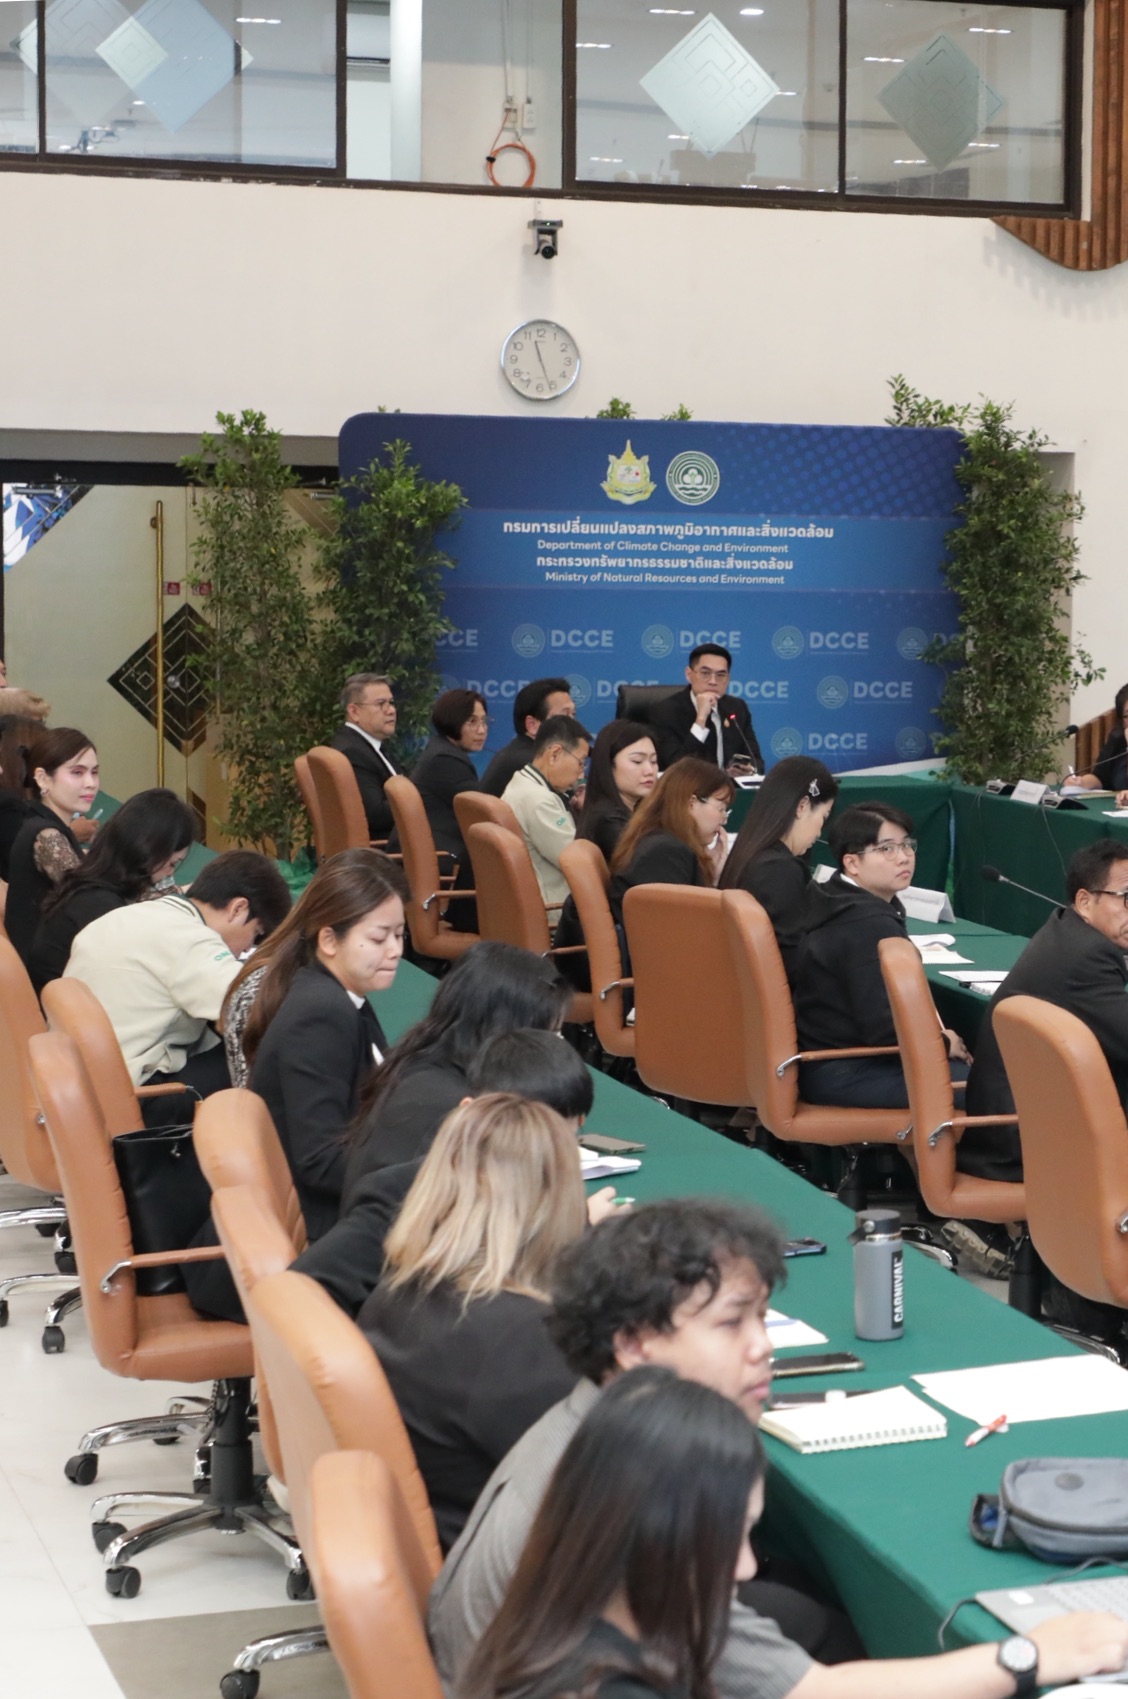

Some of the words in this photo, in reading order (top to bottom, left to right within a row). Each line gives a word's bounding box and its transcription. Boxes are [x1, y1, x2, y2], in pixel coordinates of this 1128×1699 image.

[524, 331, 531, 340] 11
[536, 328, 546, 338] 12
[513, 341, 523, 351] 10
[560, 342, 568, 352] 2
[509, 354, 518, 364] 9
[563, 356, 572, 366] 3
[513, 368, 521, 378] 8
[559, 370, 567, 378] 4
[535, 383, 544, 393] 6
[503, 516, 834, 539] กรมการเปลี่ยนแปลงสภาพภูมิอากาศและสิ่งแวดล้อม
[537, 539, 601, 552] Department
[604, 540, 615, 550] of
[617, 540, 659, 551] Climate
[660, 541, 700, 554] Change
[702, 542, 722, 552] and
[724, 543, 789, 554] Environment
[536, 553, 793, 570] กระทรวงทรัพยากรธรรมชาติและสิ่งแวดล้อม
[545, 572, 588, 584] Ministry
[590, 572, 602, 582] of
[603, 573, 643, 583] Natural
[644, 573, 697, 584] Resources
[699, 574, 719, 584] and
[721, 574, 785, 585] Environment
[551, 629, 614, 647] DCCE
[680, 630, 741, 648] DCCE
[809, 631, 869, 649] DCCE
[729, 680, 789, 698] DCCE
[854, 681, 912, 699] DCCE
[808, 733, 868, 750] DCCE
[893, 1259, 903, 1323] CARNIVAL
